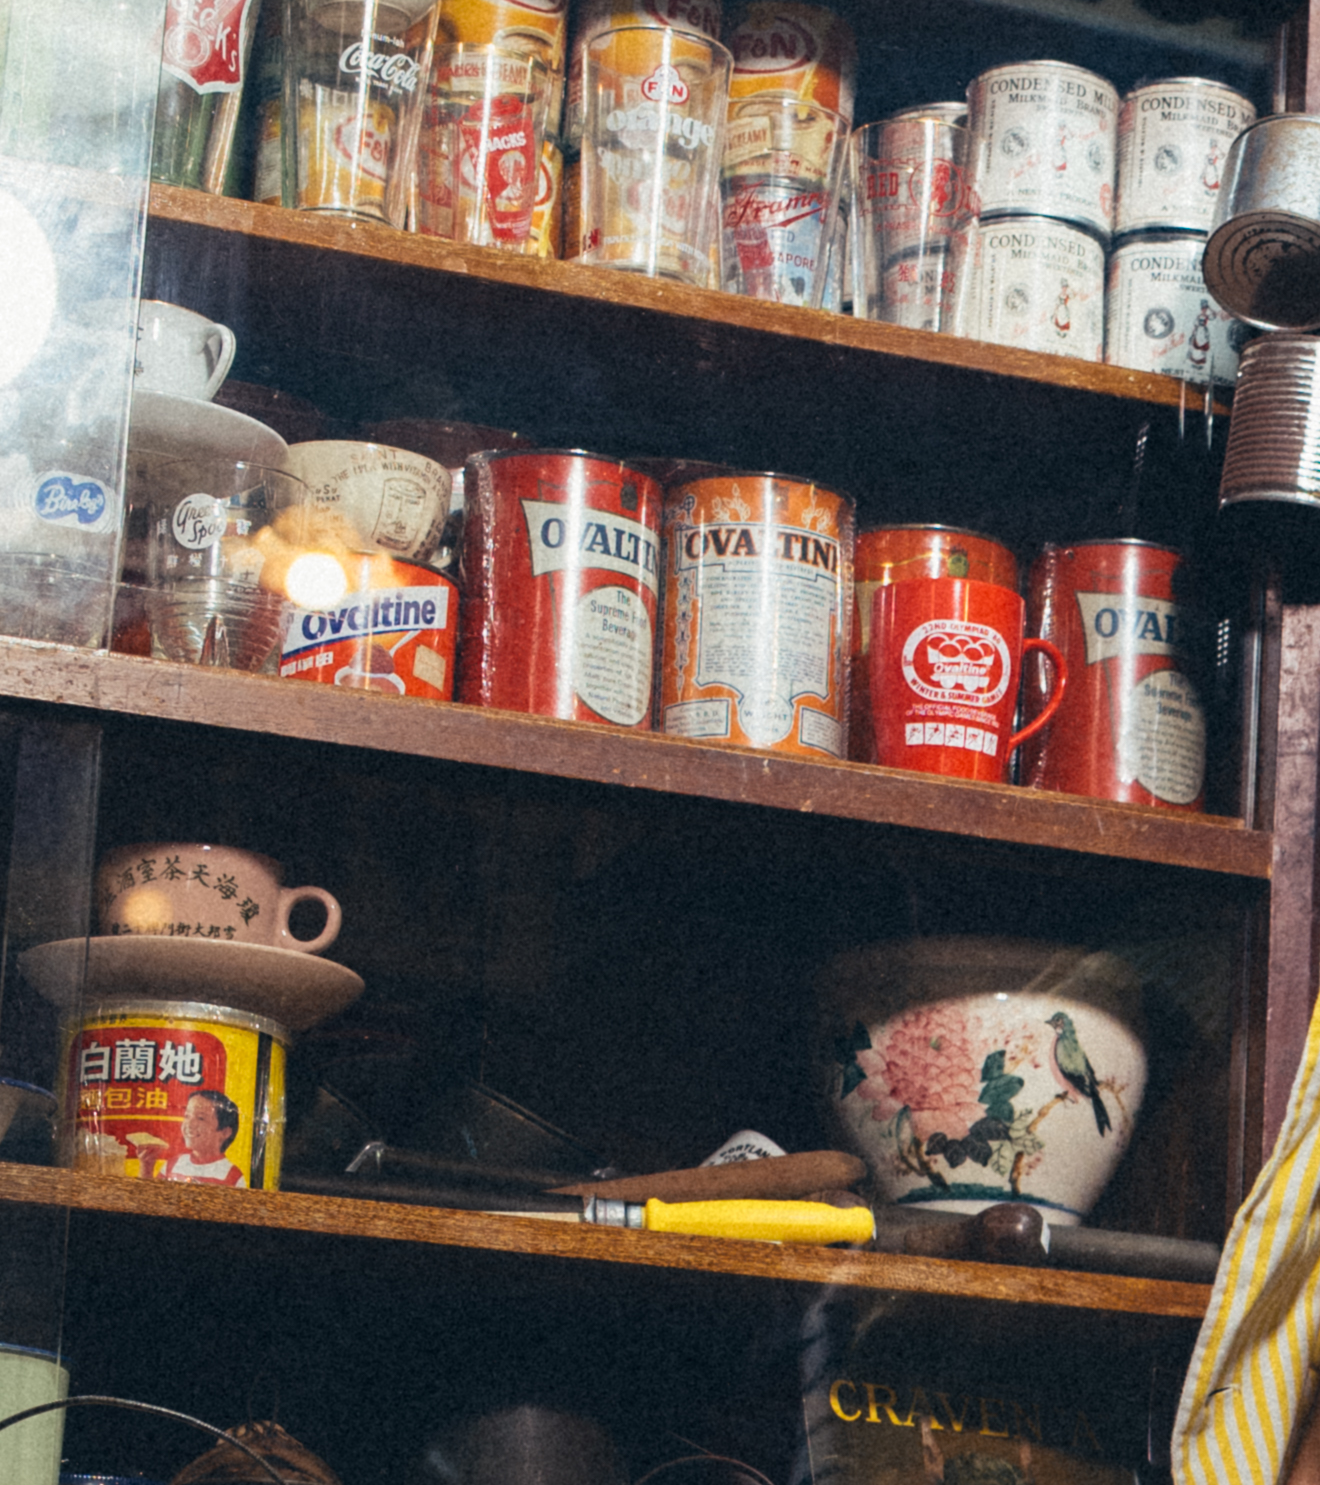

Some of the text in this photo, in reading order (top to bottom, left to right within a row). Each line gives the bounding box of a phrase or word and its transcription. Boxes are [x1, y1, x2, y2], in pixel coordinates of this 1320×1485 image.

[990, 77, 1087, 99] CONDENSED
[1140, 95, 1237, 120] CONDENSED
[606, 101, 716, 149] orange
[867, 171, 899, 200] RED
[590, 598, 630, 622] Supreme
[616, 590, 632, 607] The
[933, 662, 990, 676] Ovaltine
[79, 1038, 203, 1085] 白蘭她
[828, 1379, 1043, 1442] CRAVEN
